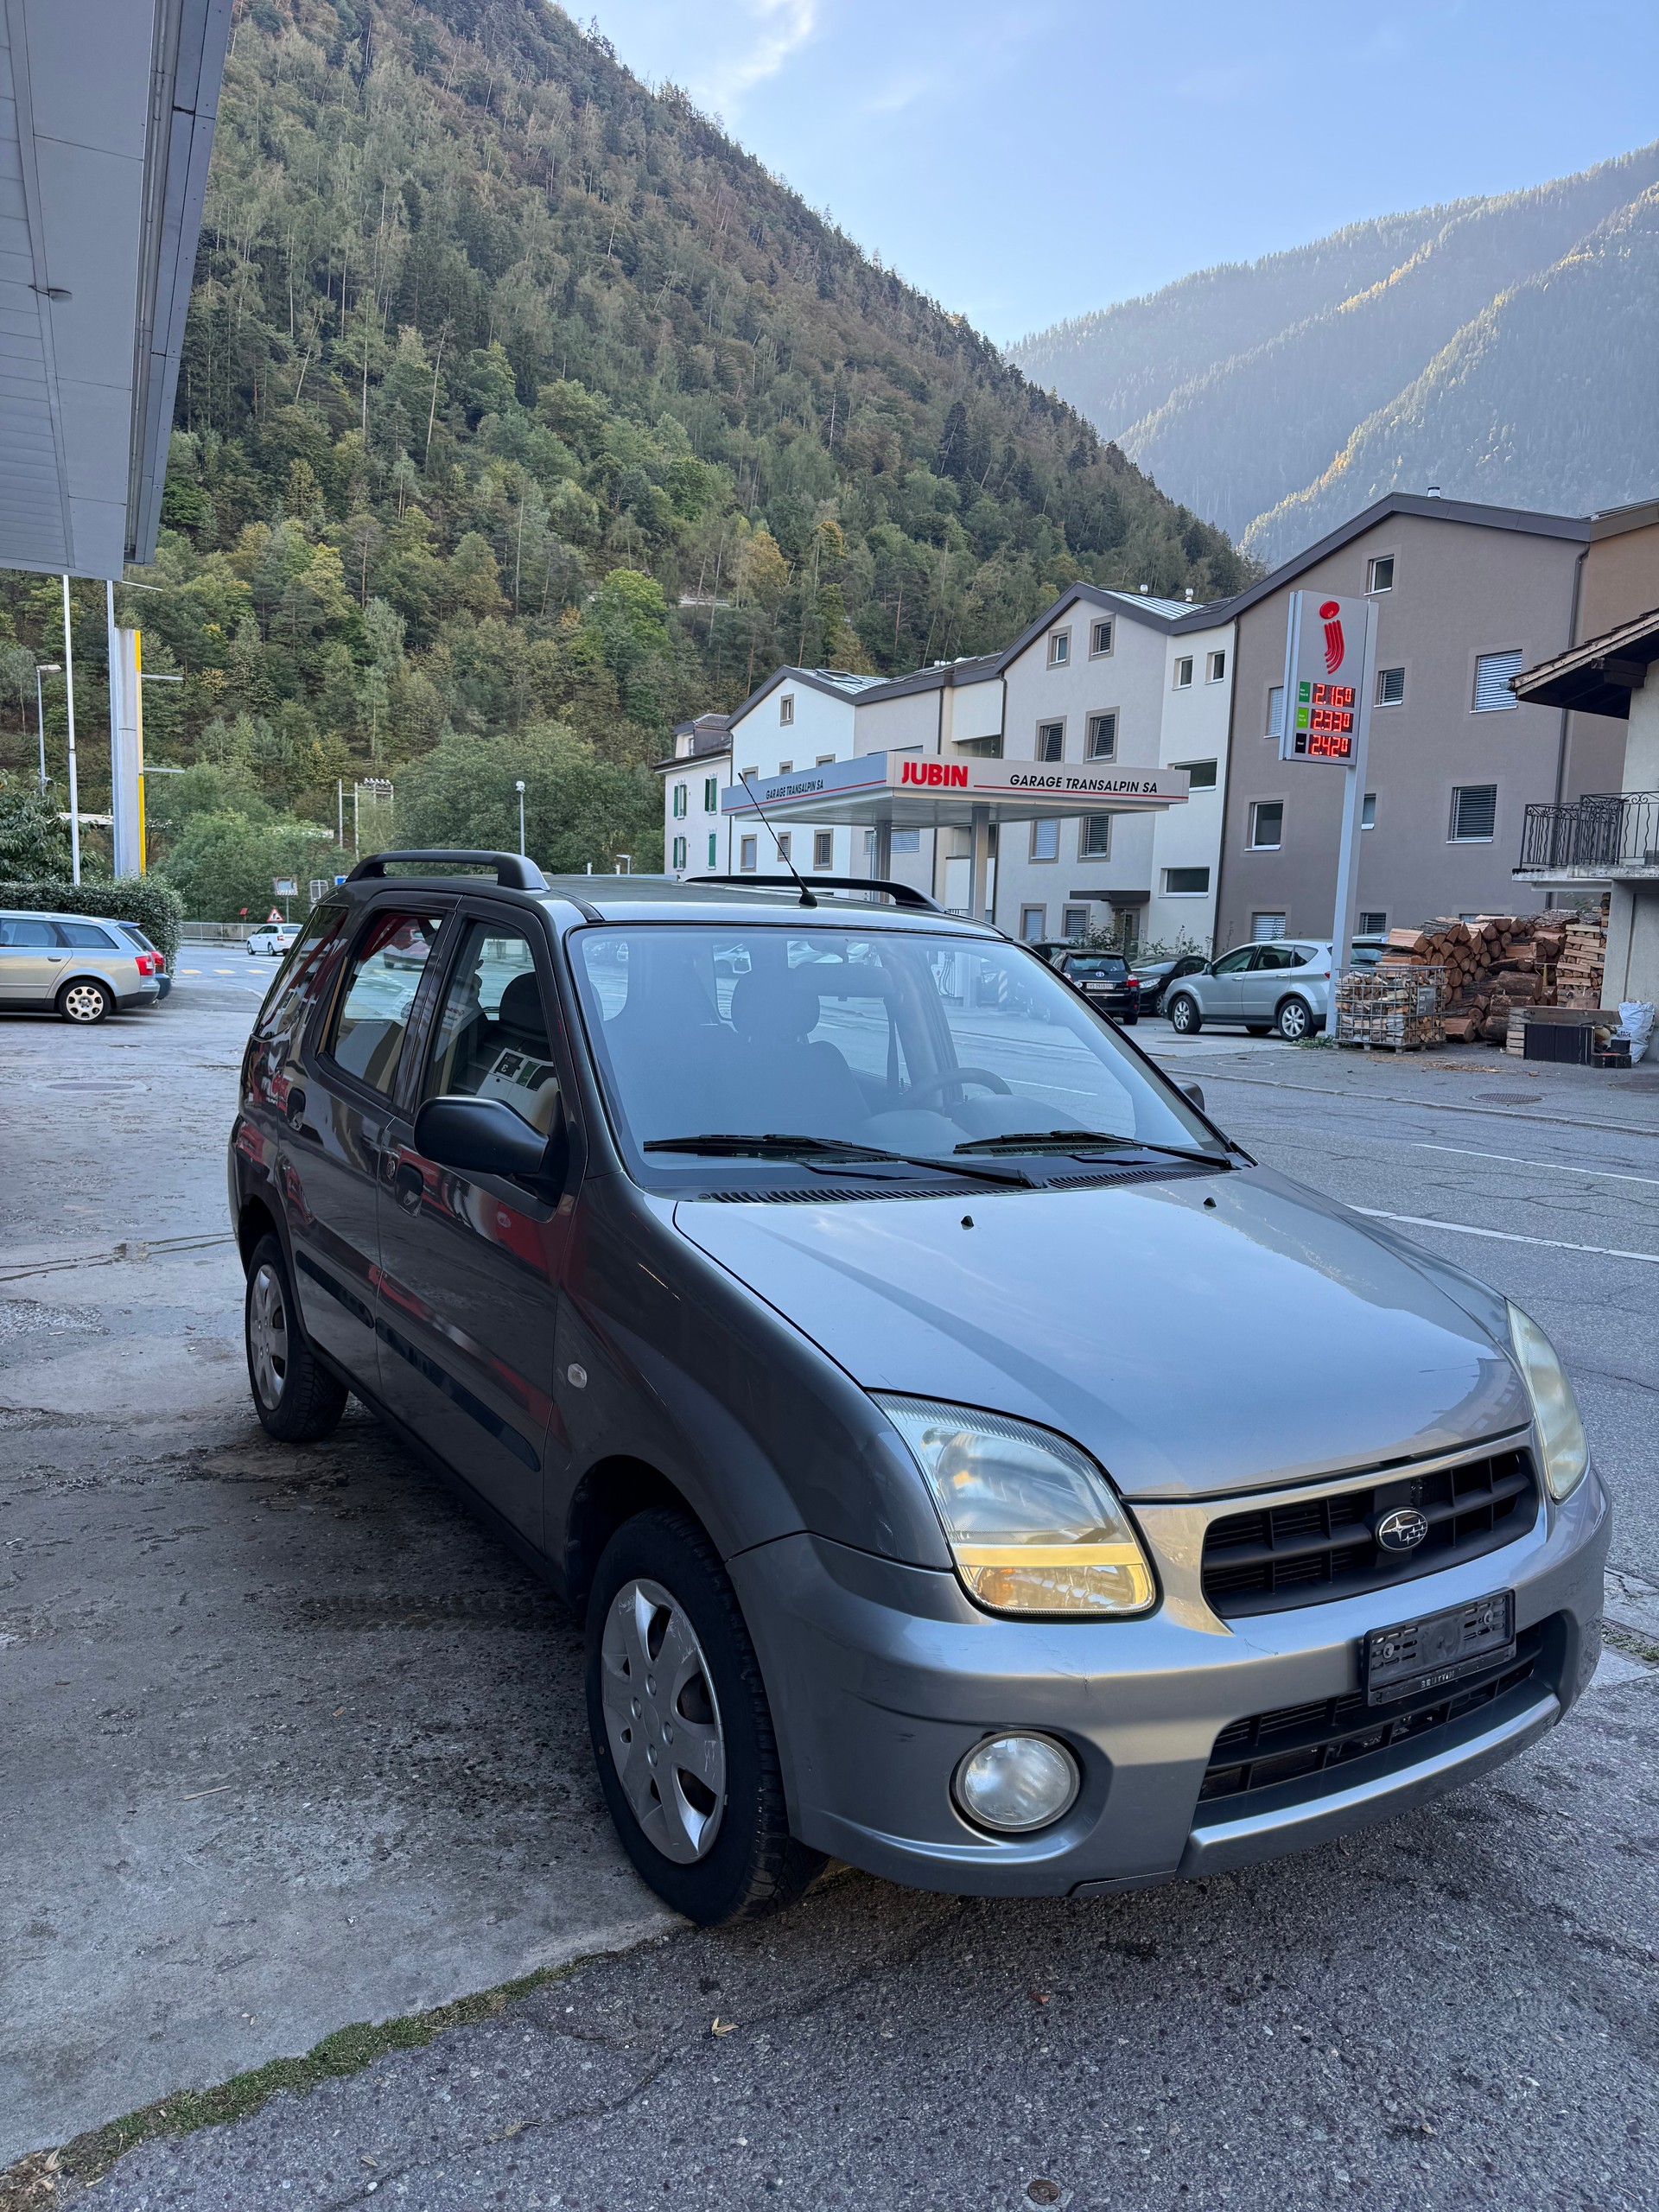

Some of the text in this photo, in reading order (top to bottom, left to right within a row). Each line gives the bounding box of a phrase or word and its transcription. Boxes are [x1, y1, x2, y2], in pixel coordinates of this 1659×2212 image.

[901, 761, 969, 787] JUBIN
[1009, 774, 1158, 793] GARAGE TRANSALPIN SA
[766, 779, 823, 800] GARAGE TRANSALPIN SA
